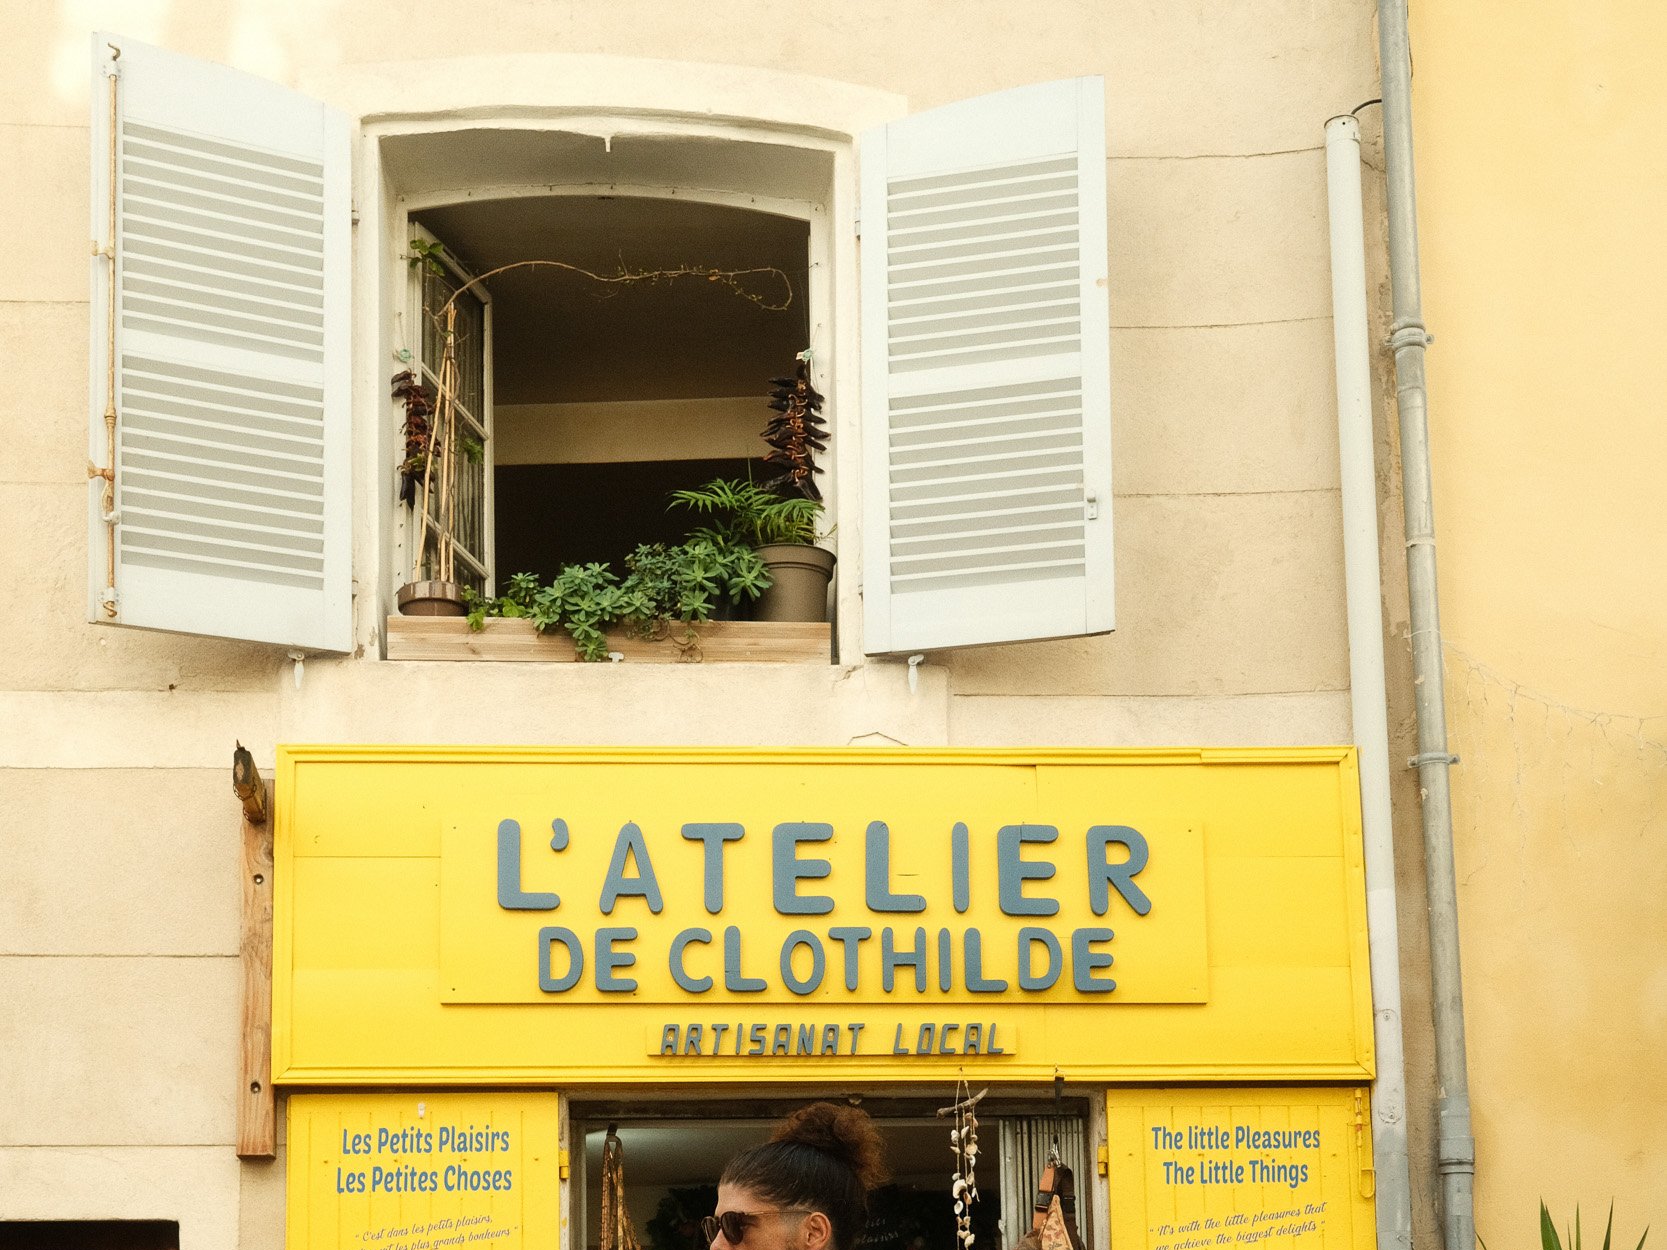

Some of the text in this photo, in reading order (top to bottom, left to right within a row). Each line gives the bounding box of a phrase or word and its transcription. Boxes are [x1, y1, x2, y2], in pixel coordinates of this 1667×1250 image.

[497, 818, 1152, 915] L'ATELIER
[538, 925, 1117, 995] DE CLOTHILDE
[660, 1023, 1004, 1055] ARTISANAT LOCAL
[343, 1125, 510, 1154] Les Petits Plaisirs
[1152, 1126, 1320, 1150] The little Pleasures
[336, 1164, 512, 1193] Les Petites Choses
[1163, 1159, 1308, 1189] The Little Things
[387, 1227, 408, 1239] dans
[412, 1223, 425, 1235] les
[427, 1218, 453, 1236] petits
[1178, 1220, 1201, 1233] with
[1204, 1218, 1221, 1230] the
[1224, 1213, 1249, 1226] little
[1251, 1208, 1301, 1226] pleasures
[1305, 1202, 1328, 1215] that
[433, 1235, 465, 1250] grands
[468, 1228, 510, 1242] bonheurs
[1173, 1237, 1212, 1250] achieve
[1216, 1233, 1232, 1245] the
[1236, 1226, 1273, 1244] biggest
[1276, 1220, 1317, 1237] delights
